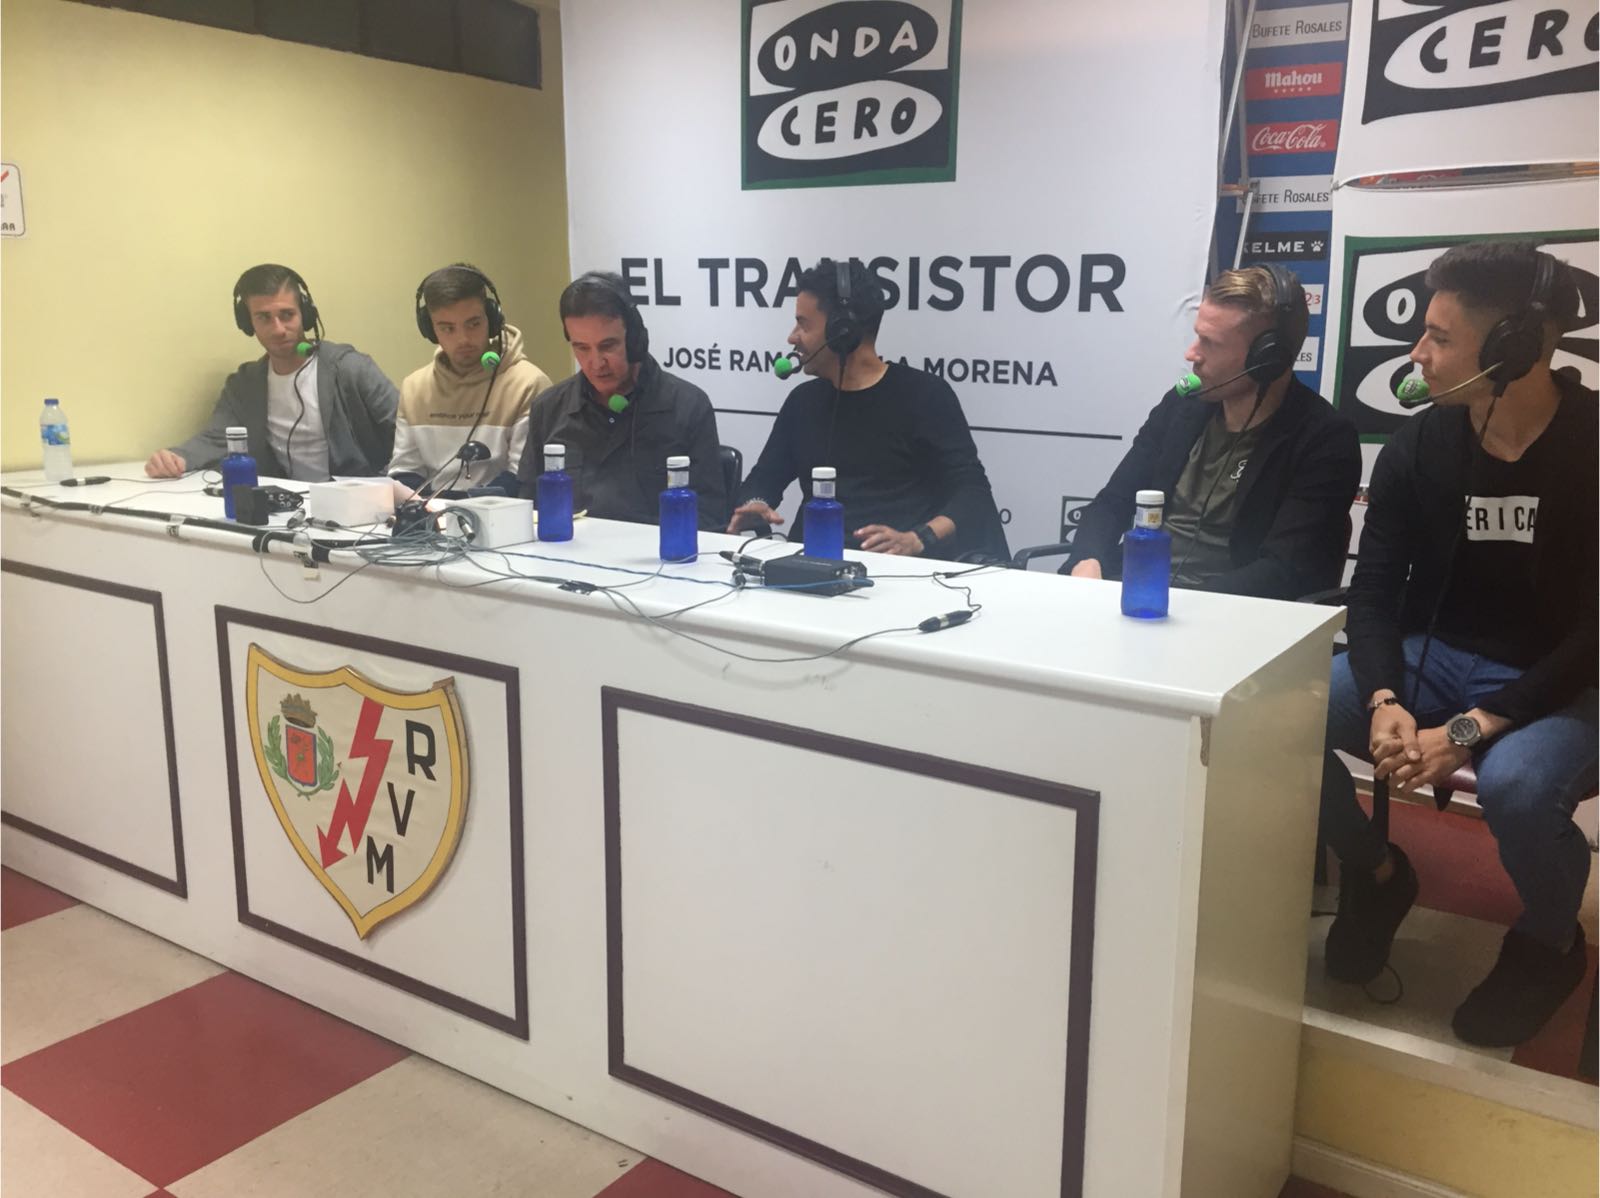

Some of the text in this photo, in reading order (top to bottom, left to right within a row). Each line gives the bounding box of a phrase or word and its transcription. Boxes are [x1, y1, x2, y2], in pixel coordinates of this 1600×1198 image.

[1252, 20, 1342, 38] BUFETE ROSALES
[774, 20, 917, 71] ONDA
[1265, 70, 1322, 88] Mahou
[781, 97, 916, 146] CERO
[1252, 123, 1327, 151] Coca-Cola
[1284, 189, 1329, 203] ROSALES
[621, 253, 1126, 313] EL TRASISTOR
[663, 343, 721, 370] JOSÉ
[924, 357, 1058, 387] MORENA
